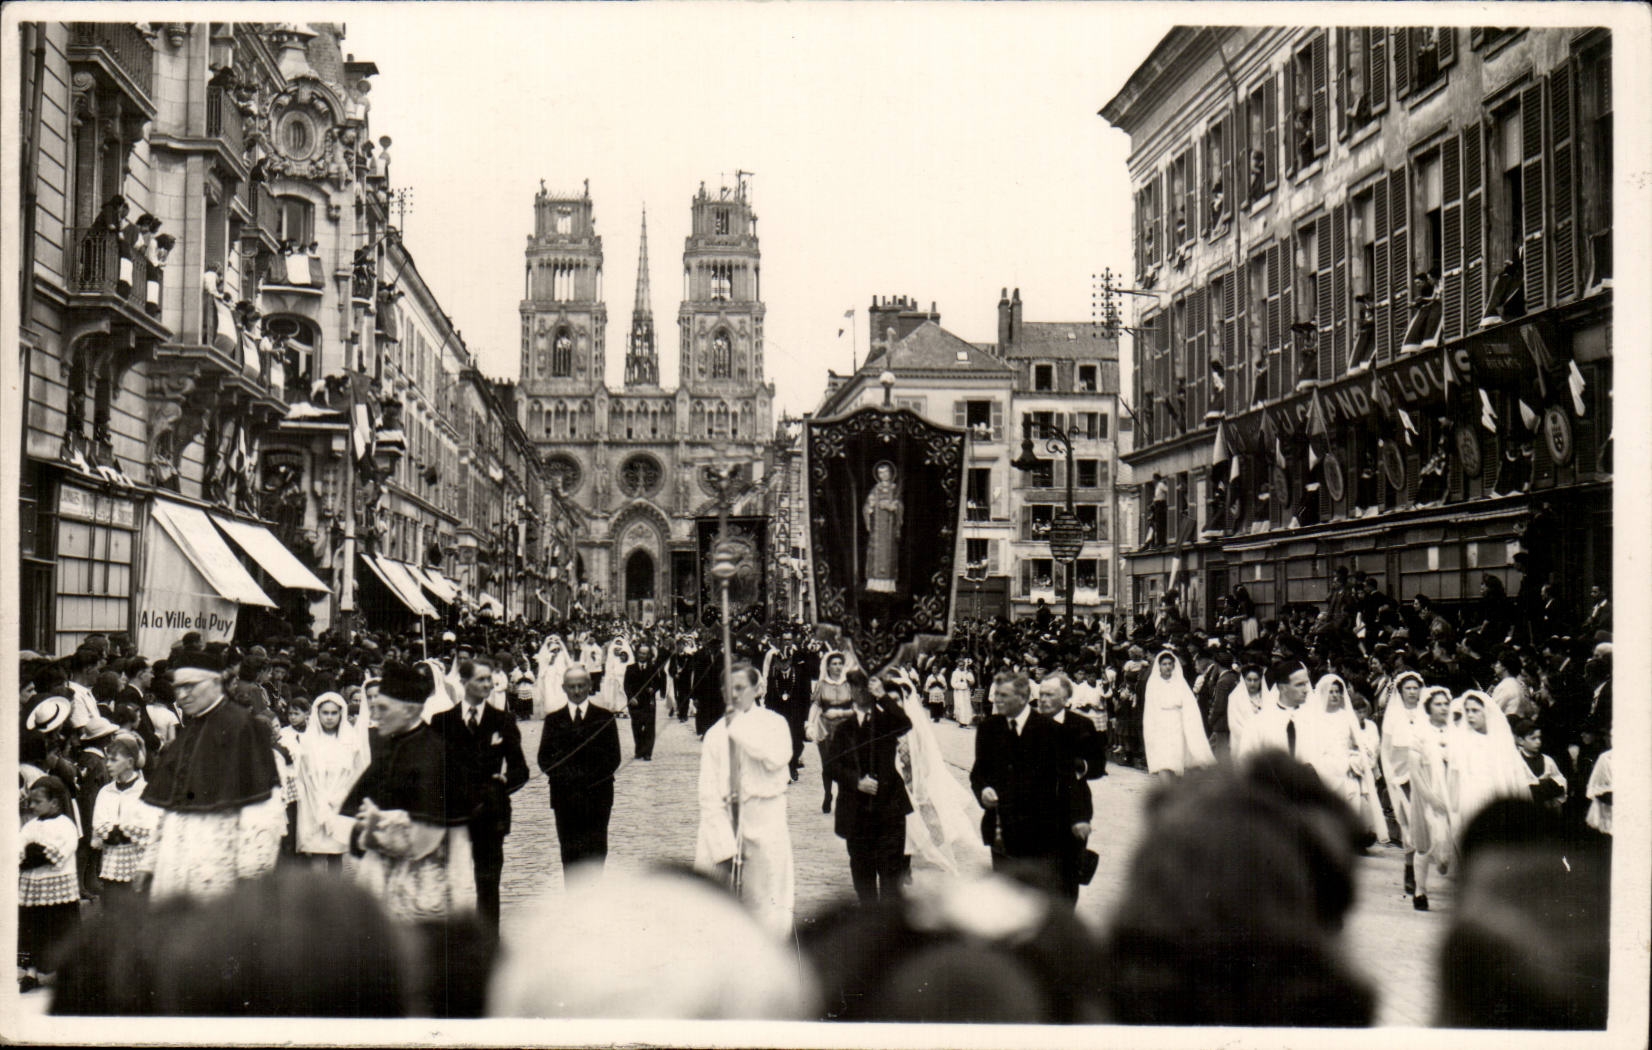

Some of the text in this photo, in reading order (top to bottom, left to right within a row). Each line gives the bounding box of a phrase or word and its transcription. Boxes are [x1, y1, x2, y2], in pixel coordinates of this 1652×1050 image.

[140, 610, 234, 638] A la Ville du Puy
